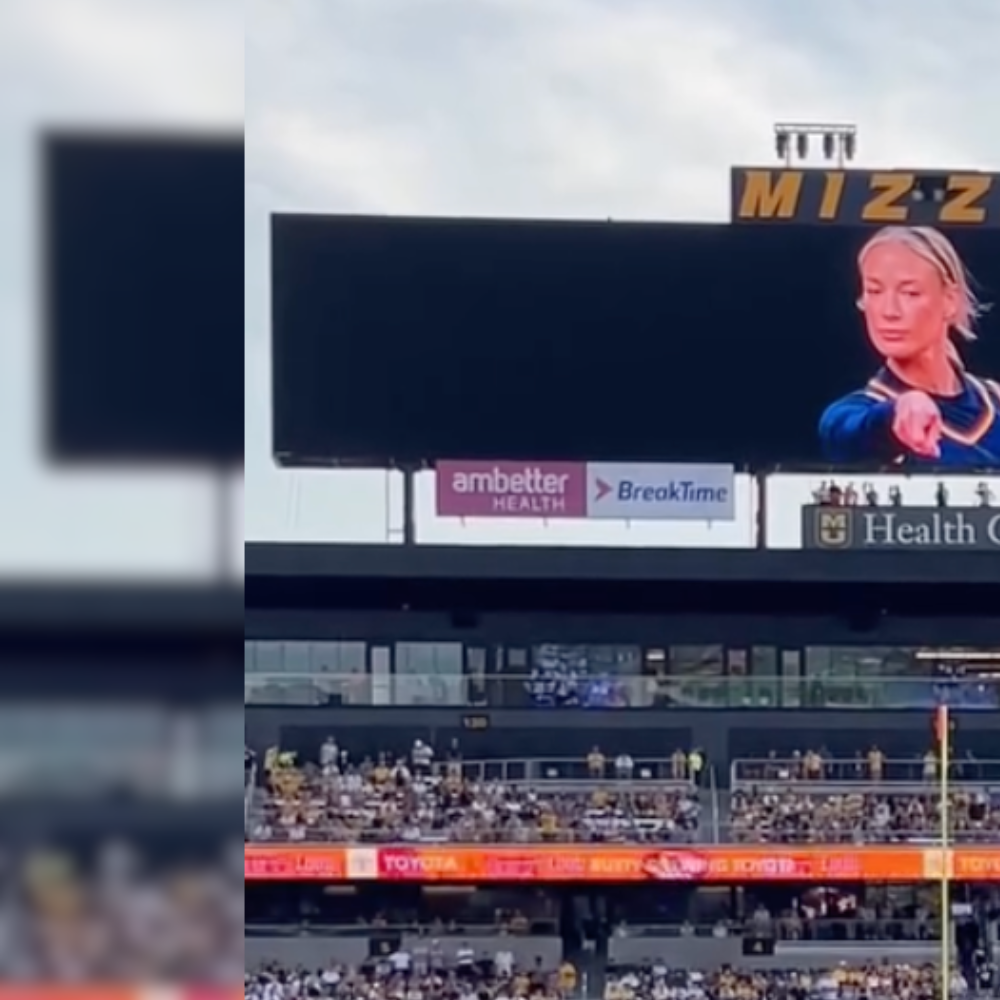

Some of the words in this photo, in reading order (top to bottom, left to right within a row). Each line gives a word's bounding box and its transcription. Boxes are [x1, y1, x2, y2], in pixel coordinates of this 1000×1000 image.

[452, 467, 570, 493] ambetter
[617, 480, 729, 503] BreakTime
[492, 496, 566, 511] HEALTH
[863, 512, 976, 545] Health
